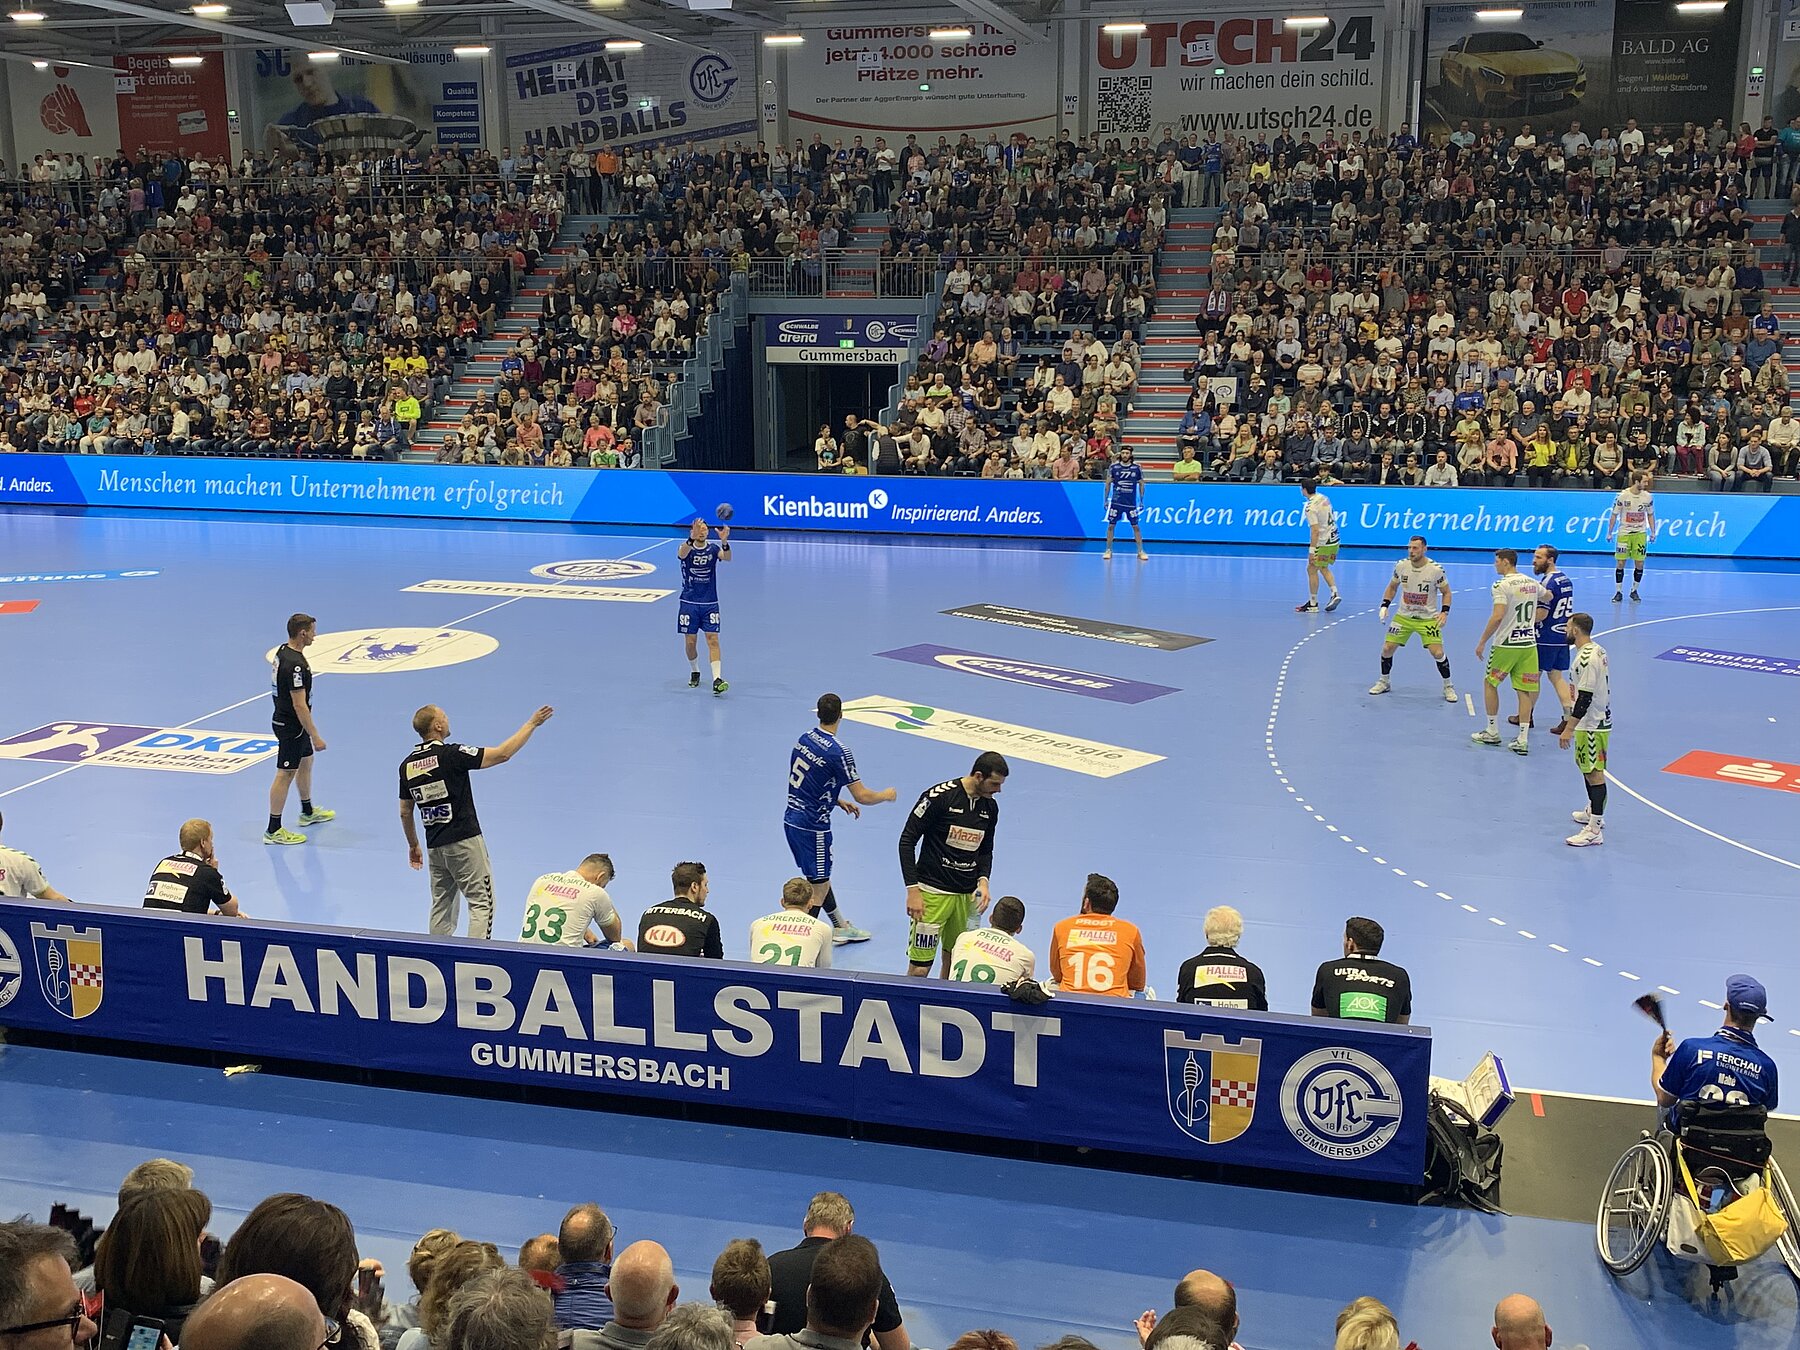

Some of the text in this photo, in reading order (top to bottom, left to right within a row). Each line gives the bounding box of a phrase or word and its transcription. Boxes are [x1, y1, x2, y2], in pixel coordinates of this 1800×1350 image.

[940, 41, 1017, 58] schöne
[1098, 16, 1375, 70] UTSCH24
[1621, 38, 1709, 55] BALD AG
[148, 72, 196, 86] einfach.
[926, 65, 983, 80] mehr.
[1181, 68, 1374, 91] wir machen dein schild.
[447, 87, 474, 97] Qualität
[1670, 84, 1708, 92] Standorte
[576, 83, 629, 116] DES
[764, 103, 777, 111] WC
[436, 110, 476, 121] Kompetenz
[1181, 104, 1372, 131] www.utsch24.de
[525, 101, 688, 153] HANDBALLS
[440, 131, 477, 140] Innovation
[778, 334, 818, 343] arena
[799, 349, 897, 362] Gummersbach
[9, 478, 54, 494] Anders.
[97, 469, 565, 511] Menschen machen Unternehmen erfolgreich
[763, 495, 869, 520] Kienbaum
[891, 502, 1044, 525] Inspirierend. Anders.
[1359, 503, 1555, 535] Unternehmen
[418, 583, 661, 599] Gummersbach
[1417, 583, 1430, 593] 14
[680, 614, 690, 626] SC
[1515, 601, 1534, 623] 10
[1672, 648, 1767, 664] Schmidt
[1685, 656, 1778, 672] Stahlharte
[962, 659, 1114, 690] SCHWALBE
[135, 733, 279, 755] DKB
[944, 718, 1124, 760] AggerEnergie
[98, 755, 233, 770] Bundesliga
[112, 749, 249, 764] Handball
[412, 756, 438, 770] HALLER
[789, 756, 810, 789] 5
[165, 860, 197, 874] HALLER
[159, 891, 183, 901] Gruppe
[545, 884, 581, 899] HALLER
[521, 903, 567, 943] 33
[772, 923, 812, 935] HALLER
[650, 928, 677, 944] KIA
[915, 933, 938, 948] EMAG
[1078, 930, 1116, 943] HALLER
[759, 943, 802, 967] 21
[974, 940, 1015, 961] HALLER
[1067, 951, 1115, 992] 16
[1206, 966, 1246, 979] HALLER
[1334, 967, 1367, 976] ULTRA
[1346, 974, 1395, 988] SPORTS
[184, 936, 1061, 1088] HANDBALLSTADT
[1217, 1000, 1239, 1009] Hahn
[1348, 997, 1380, 1011] AOK
[1331, 1050, 1353, 1061] VfL
[1717, 1052, 1762, 1074] FERCHAU
[471, 1042, 731, 1091] GUMMERSBACH
[1716, 1061, 1760, 1080] ENGINEERING
[1325, 1122, 1353, 1132] 18 61
[1295, 1128, 1384, 1157] GUMMERSBACH
